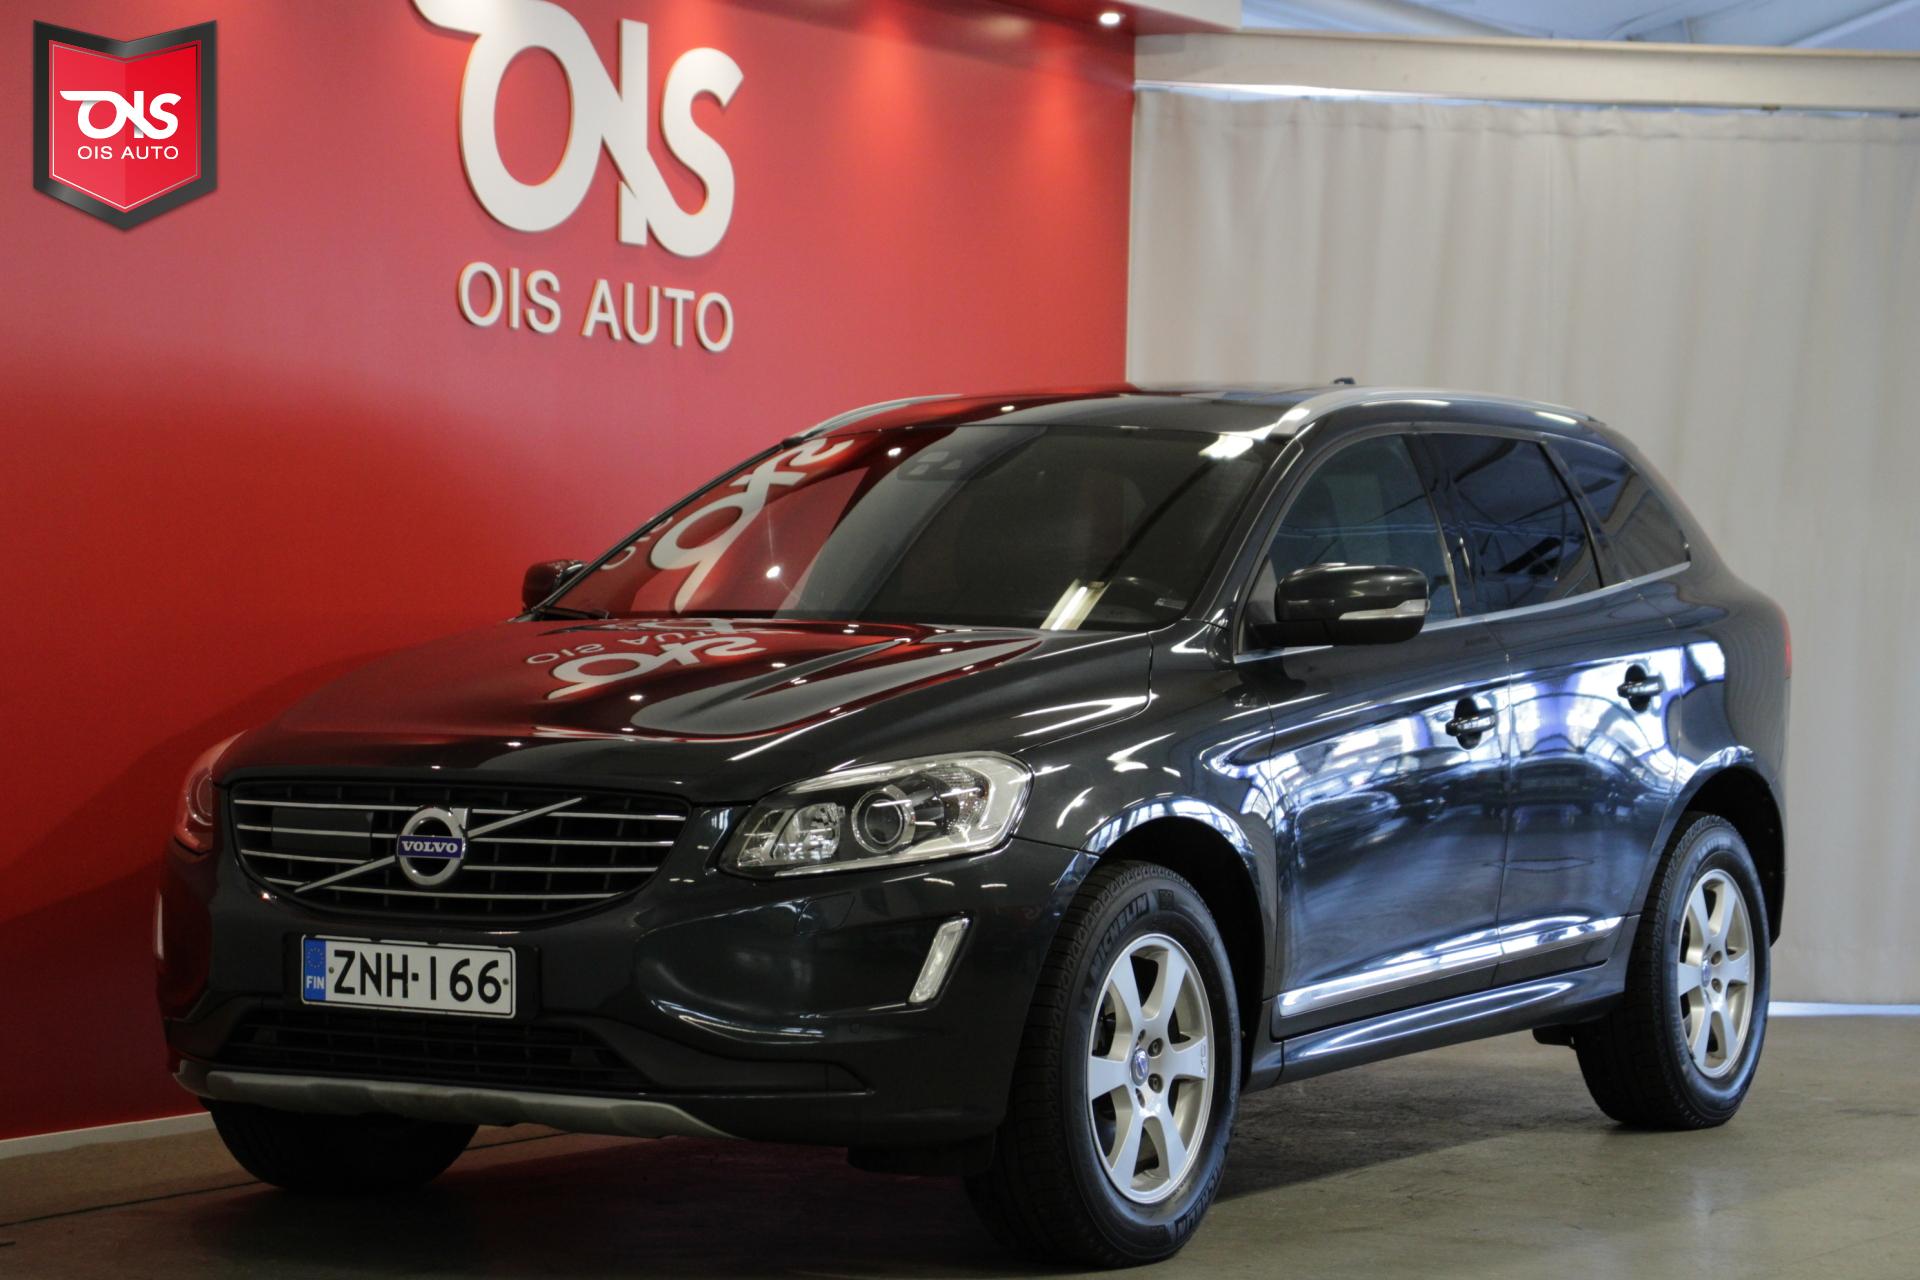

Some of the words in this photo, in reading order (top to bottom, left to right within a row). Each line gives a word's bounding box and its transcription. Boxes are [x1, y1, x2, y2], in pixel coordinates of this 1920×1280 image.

[413, 0, 744, 257] OIS
[458, 262, 561, 333] OIS
[581, 278, 734, 352] AUTO
[401, 840, 459, 853] VOLVO
[305, 975, 325, 990] FIN
[333, 949, 503, 1004] ZNH-166
